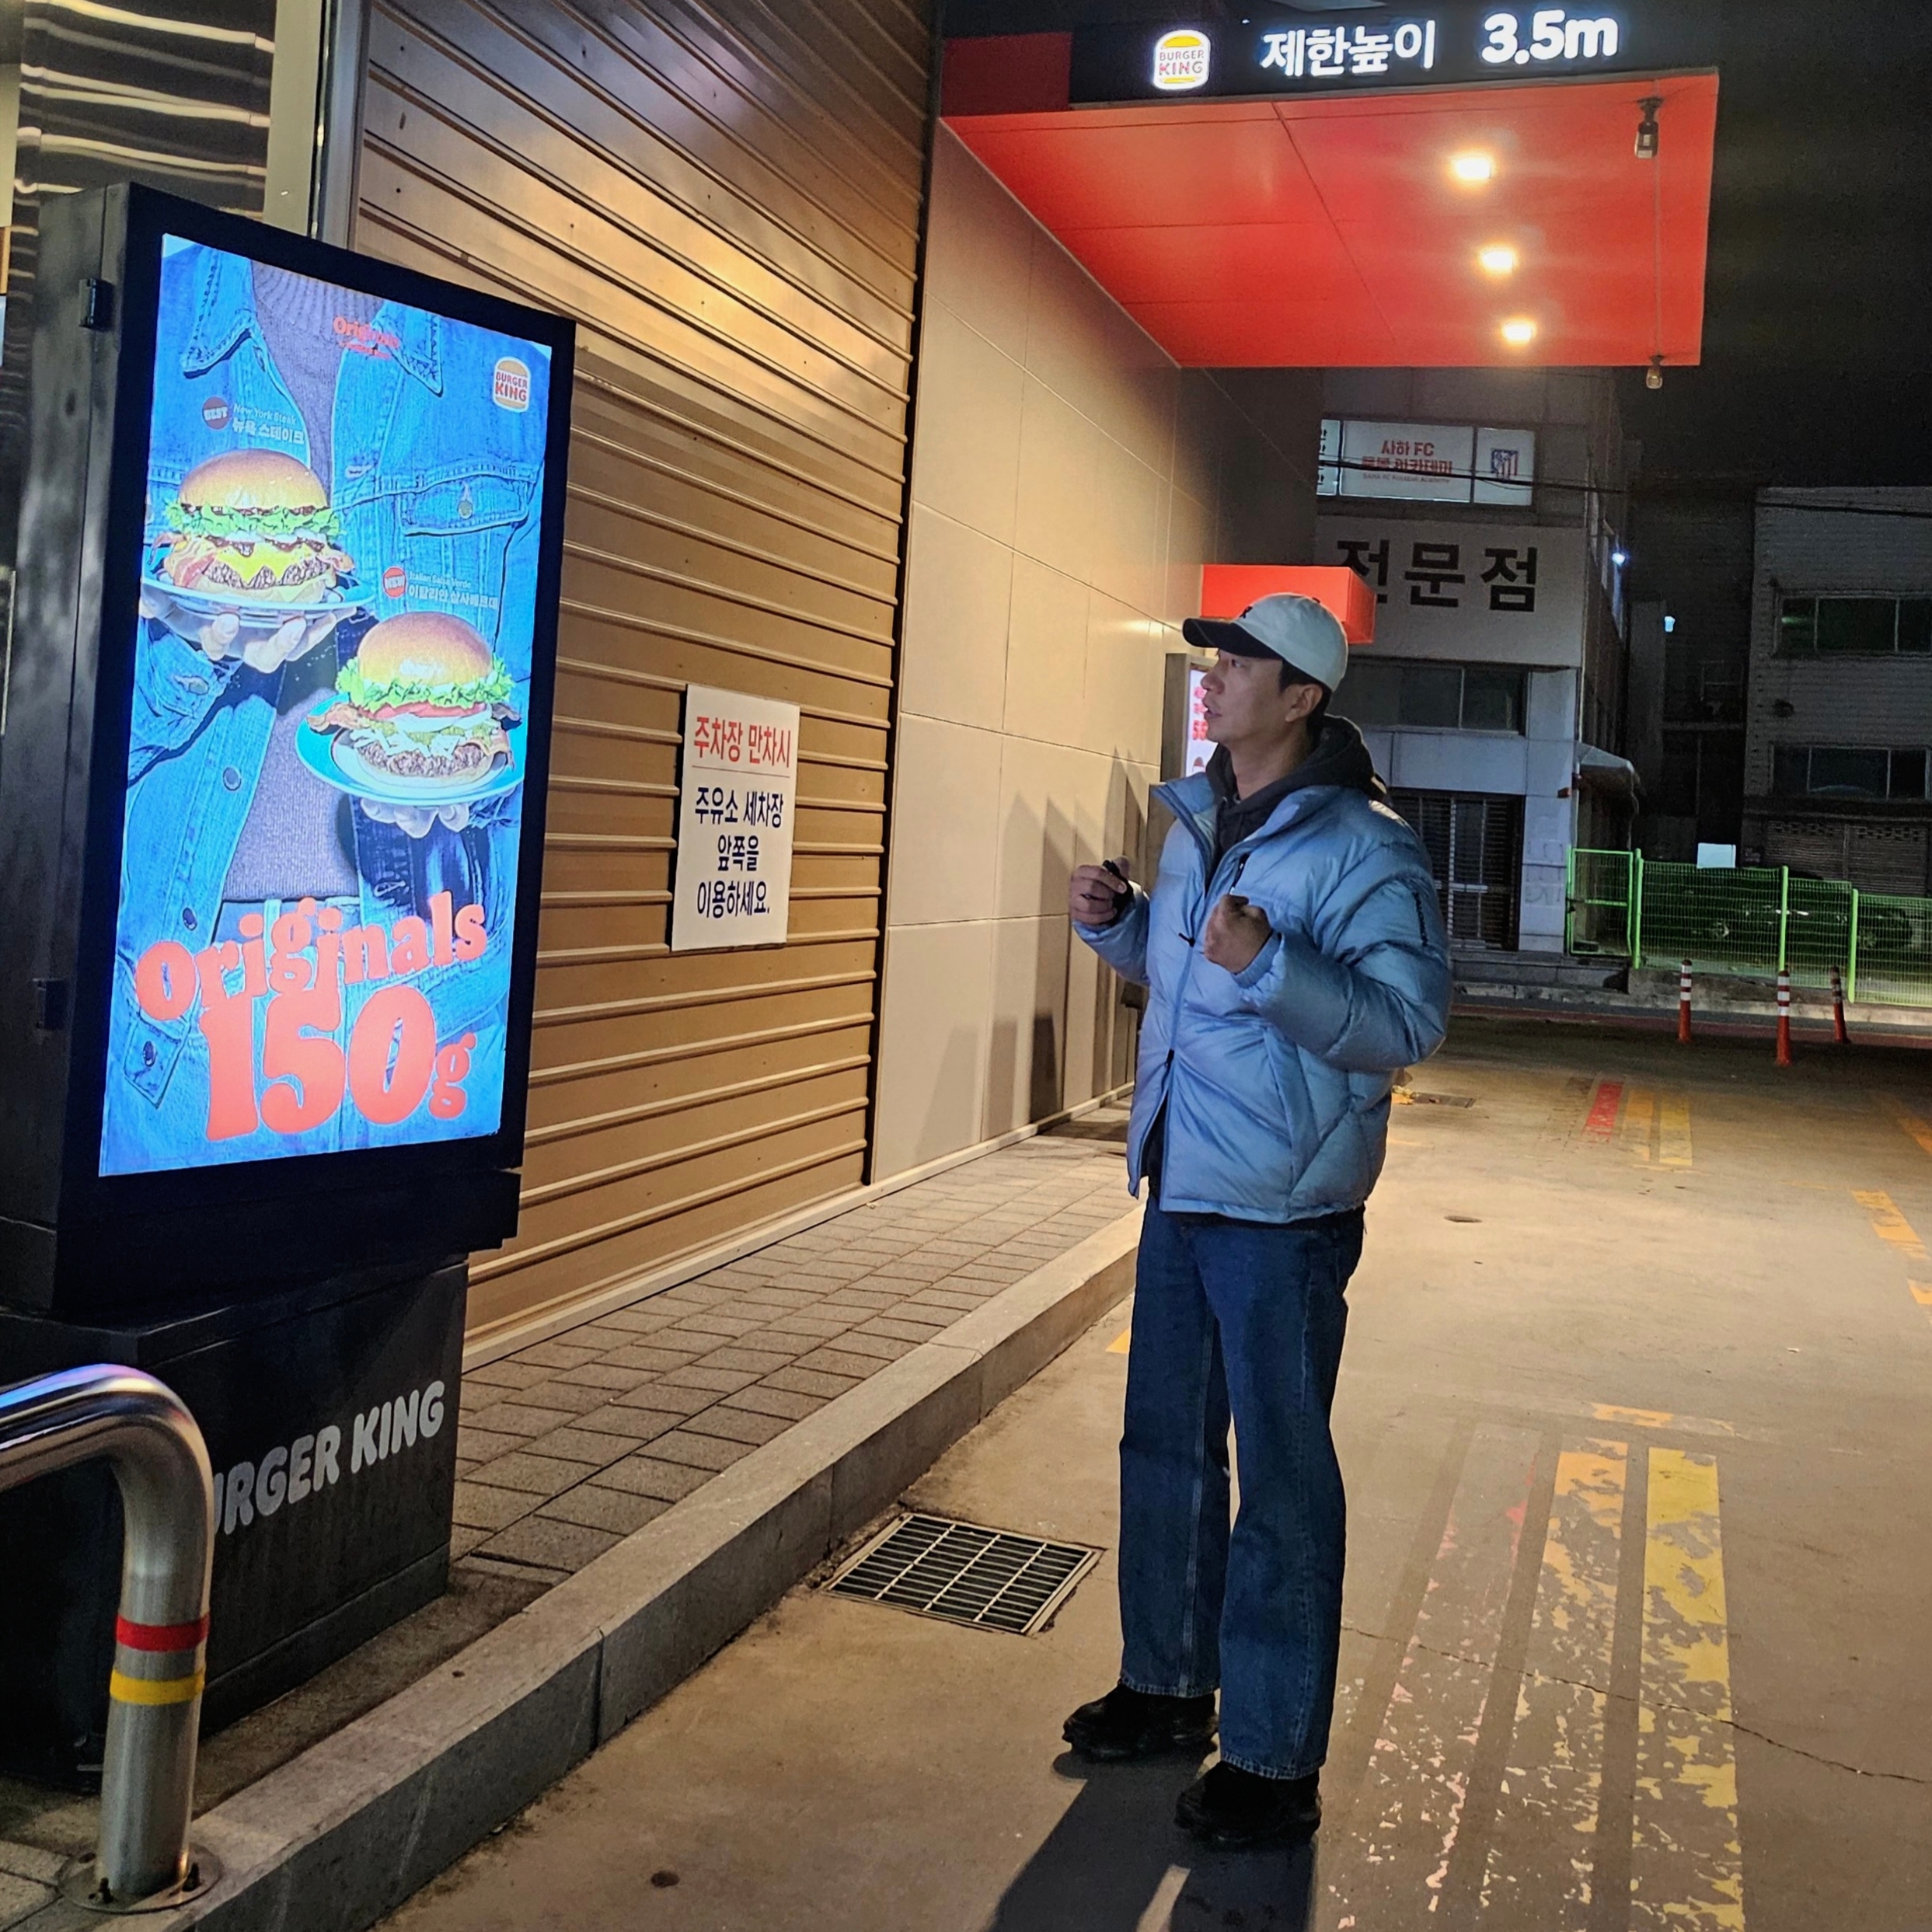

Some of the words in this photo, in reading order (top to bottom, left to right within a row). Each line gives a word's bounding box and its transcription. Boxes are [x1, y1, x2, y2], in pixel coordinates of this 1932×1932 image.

[1159, 49, 1205, 61] BURGER
[1260, 19, 1435, 78] 제한높이
[1481, 9, 1619, 65] 3.5m
[1159, 61, 1203, 75] KING
[495, 381, 527, 402] KING
[496, 371, 528, 389] BURGER
[233, 403, 253, 414] New
[254, 407, 273, 420] York
[232, 417, 256, 435] 뉴욕
[258, 424, 305, 445] 스테이크
[1382, 440, 1411, 455] 사하
[1414, 442, 1435, 456] FC
[1337, 539, 1538, 612] 전문점
[694, 717, 743, 762] 주차장
[748, 724, 791, 768] 만차시
[695, 786, 738, 824] 주유소
[743, 790, 783, 828] 세차장
[718, 834, 759, 871] 앞쪽을
[198, 985, 477, 1141] 150g
[214, 1425, 341, 1537] RGER
[350, 1380, 445, 1473] KING
